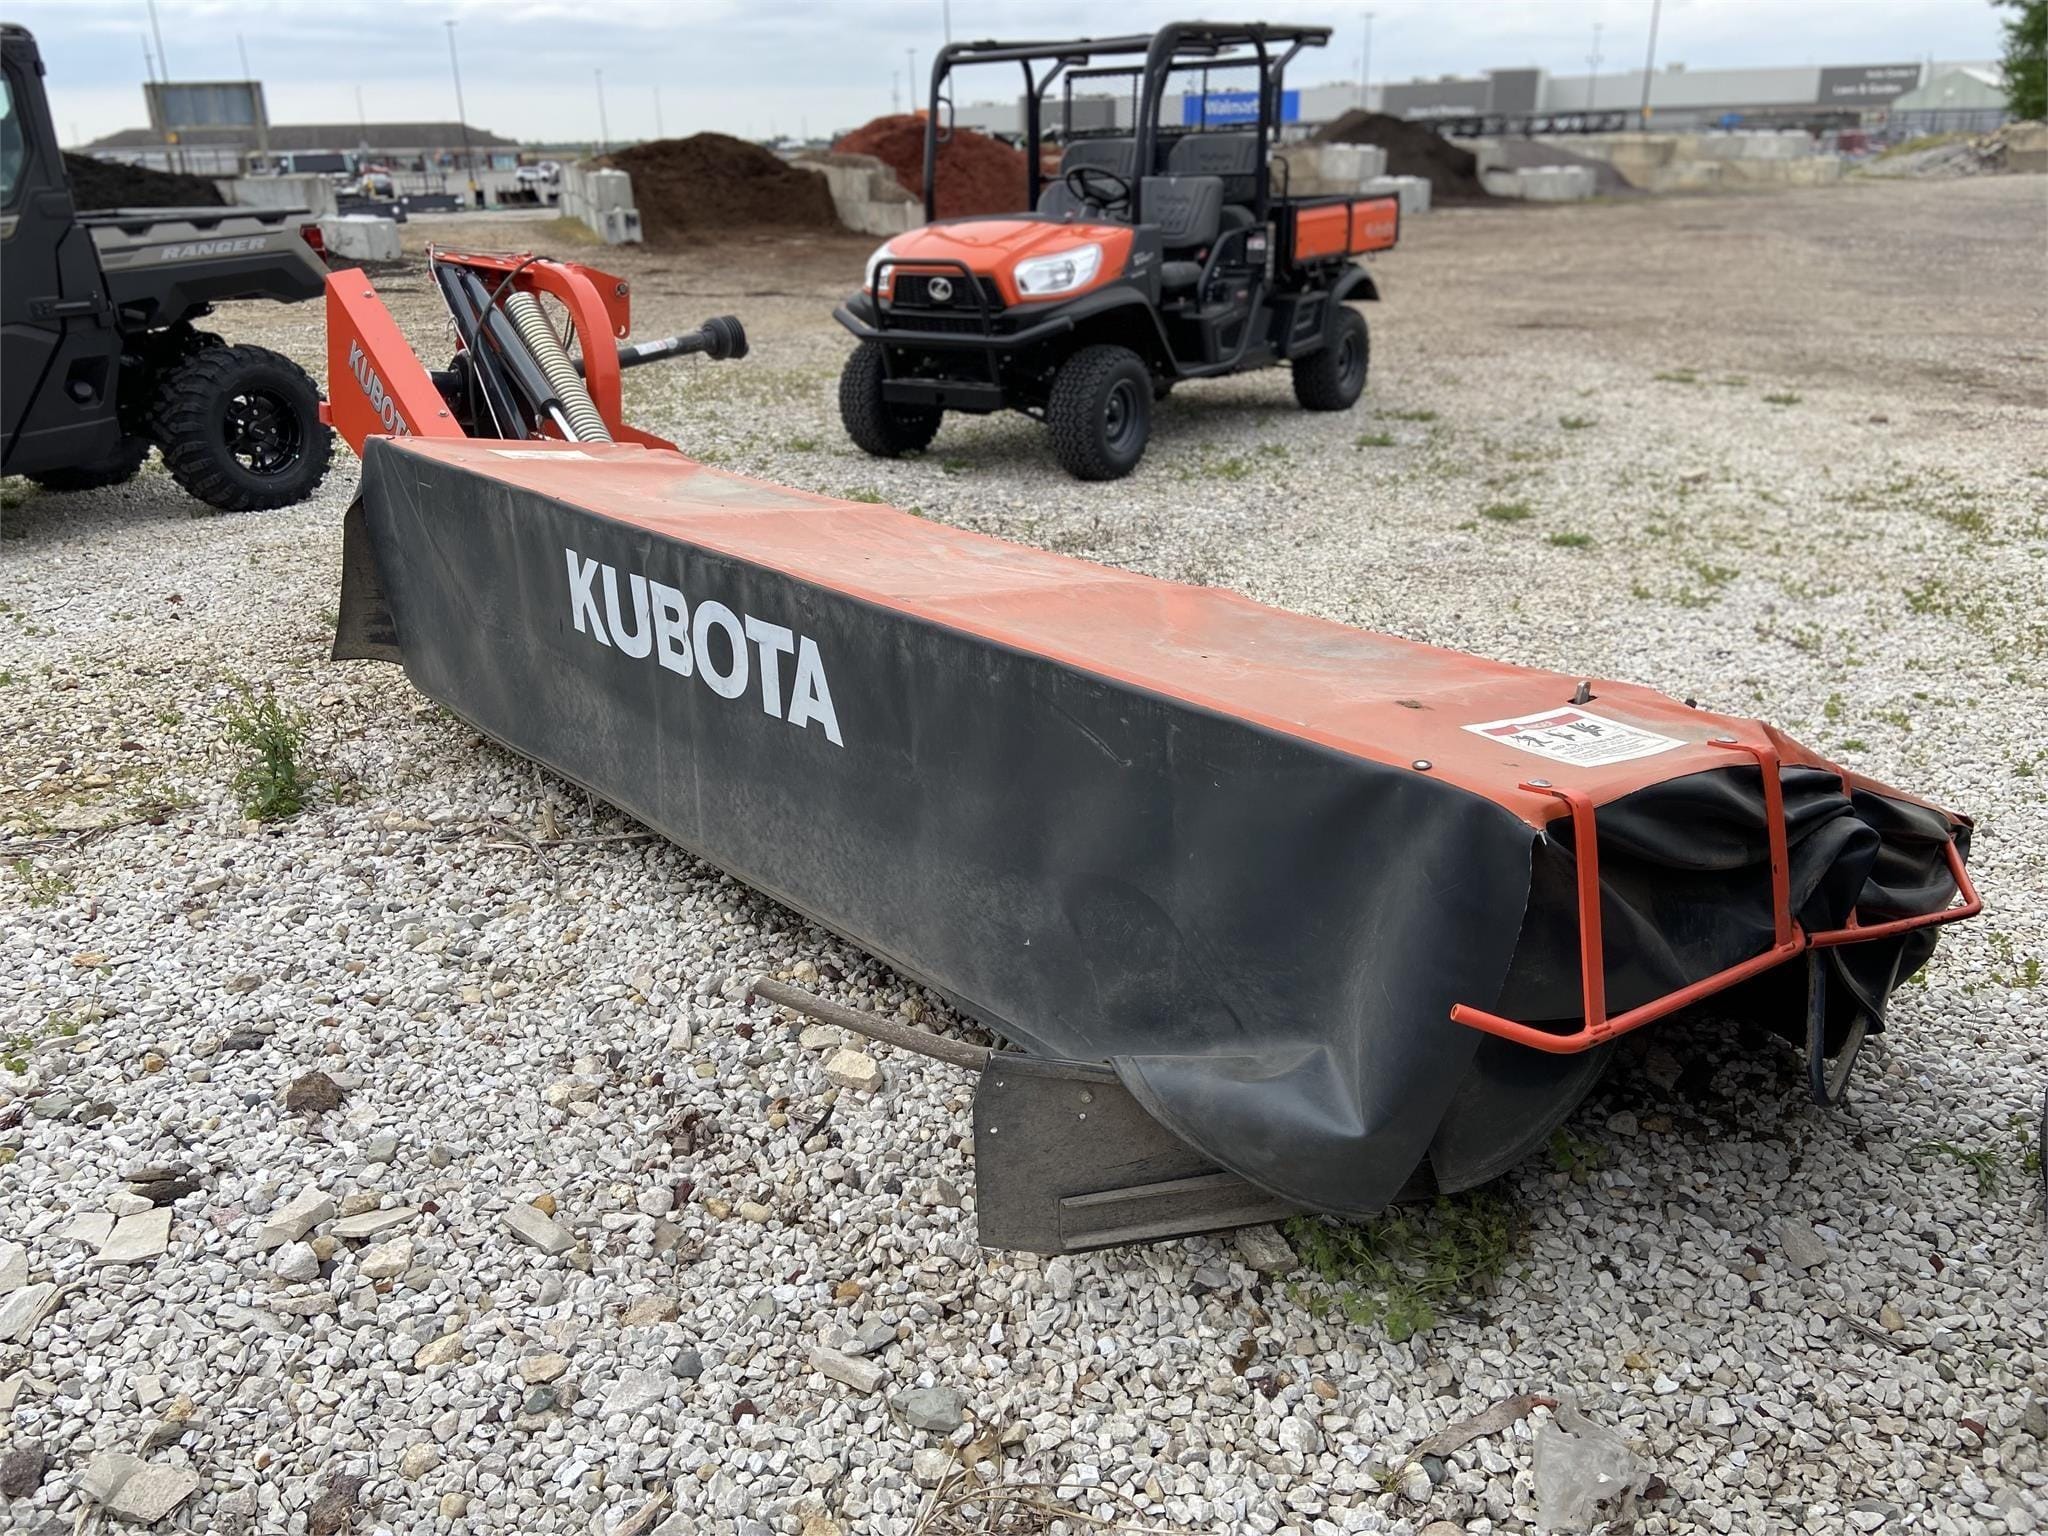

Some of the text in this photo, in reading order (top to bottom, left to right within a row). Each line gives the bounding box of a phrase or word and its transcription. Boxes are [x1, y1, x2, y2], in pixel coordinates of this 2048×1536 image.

[161, 238, 267, 260] RANGER
[348, 338, 413, 437] KUBOT
[565, 547, 844, 748] KUBOTA
